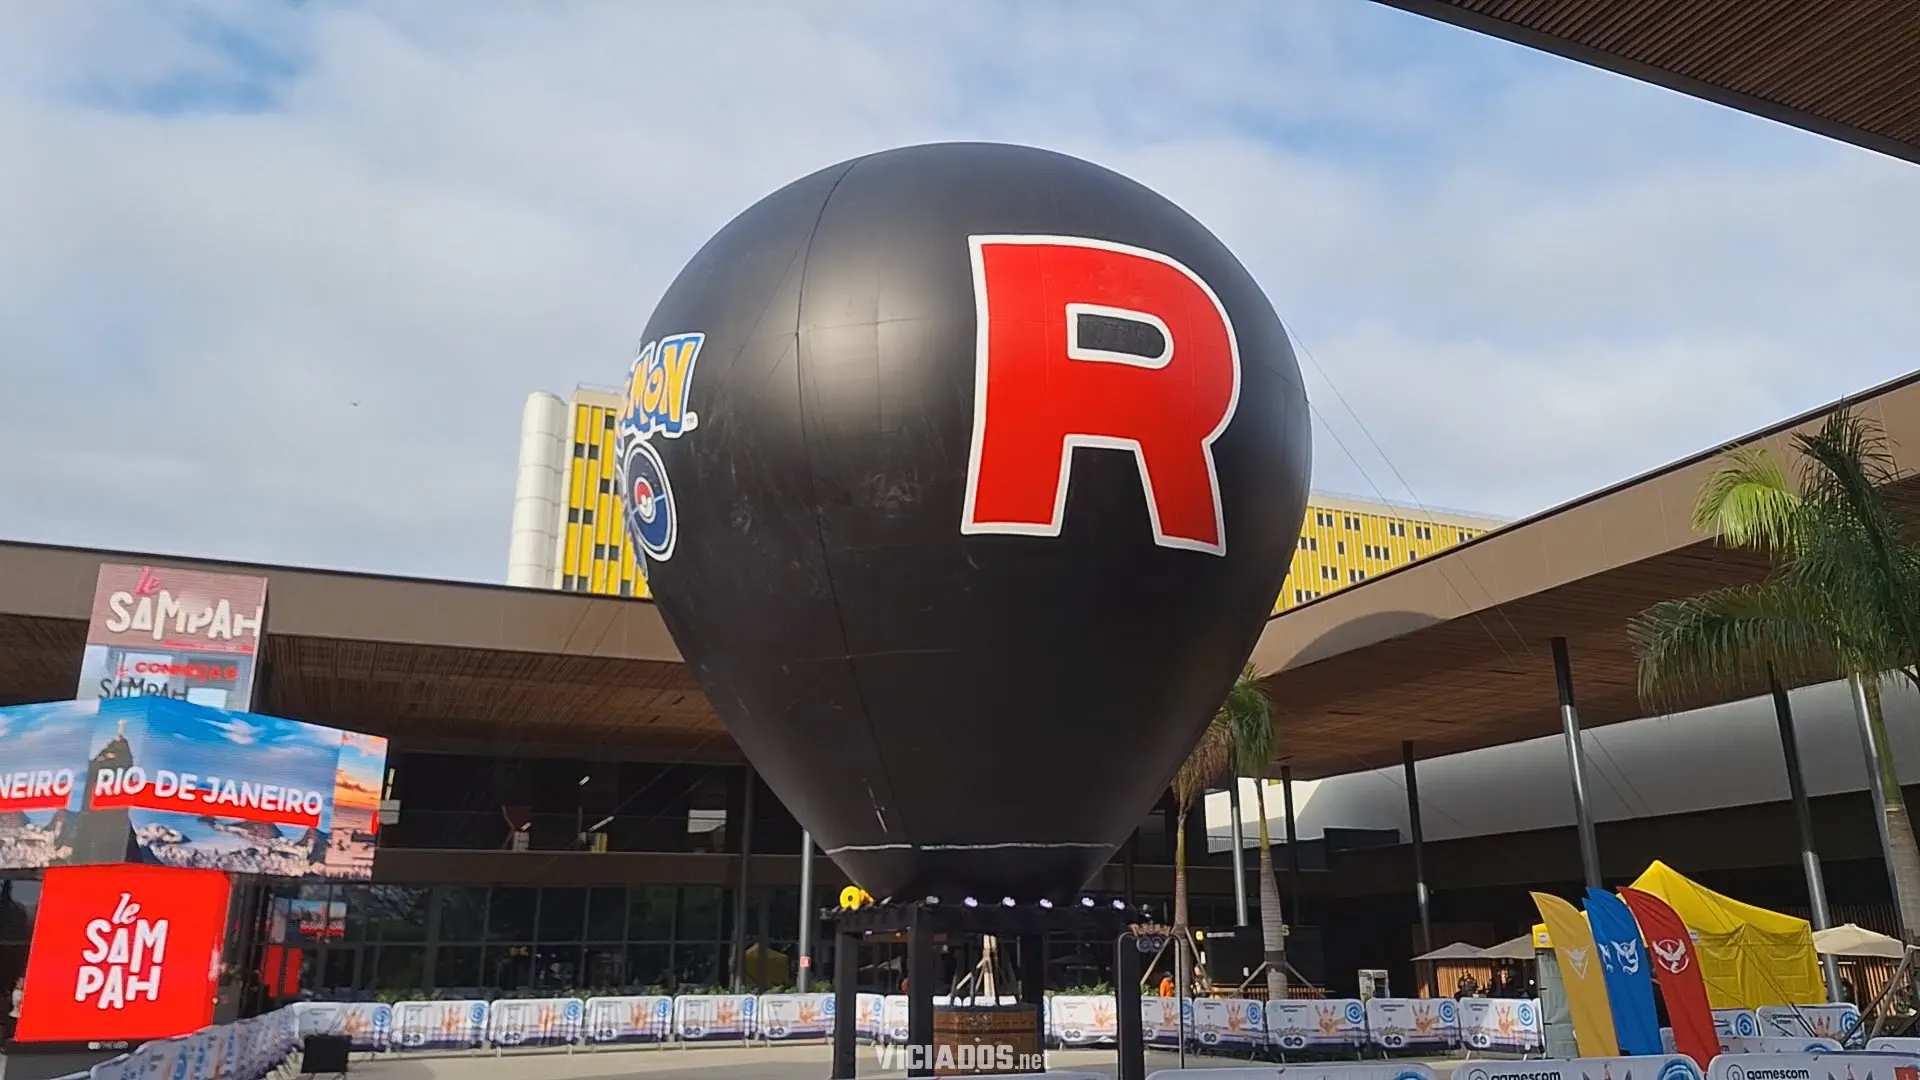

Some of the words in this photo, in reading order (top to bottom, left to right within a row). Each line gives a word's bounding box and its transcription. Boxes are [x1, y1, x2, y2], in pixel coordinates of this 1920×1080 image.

[961, 234, 1241, 557] R
[135, 566, 161, 596] le
[106, 589, 264, 641] SAMPAH
[94, 766, 147, 797] RIO
[154, 769, 198, 801] DE
[201, 776, 323, 816] JANEIRO
[112, 892, 141, 925] le
[82, 918, 169, 973] SAM
[75, 965, 161, 1009] PAH
[1746, 1069, 1810, 1080] gamescom
